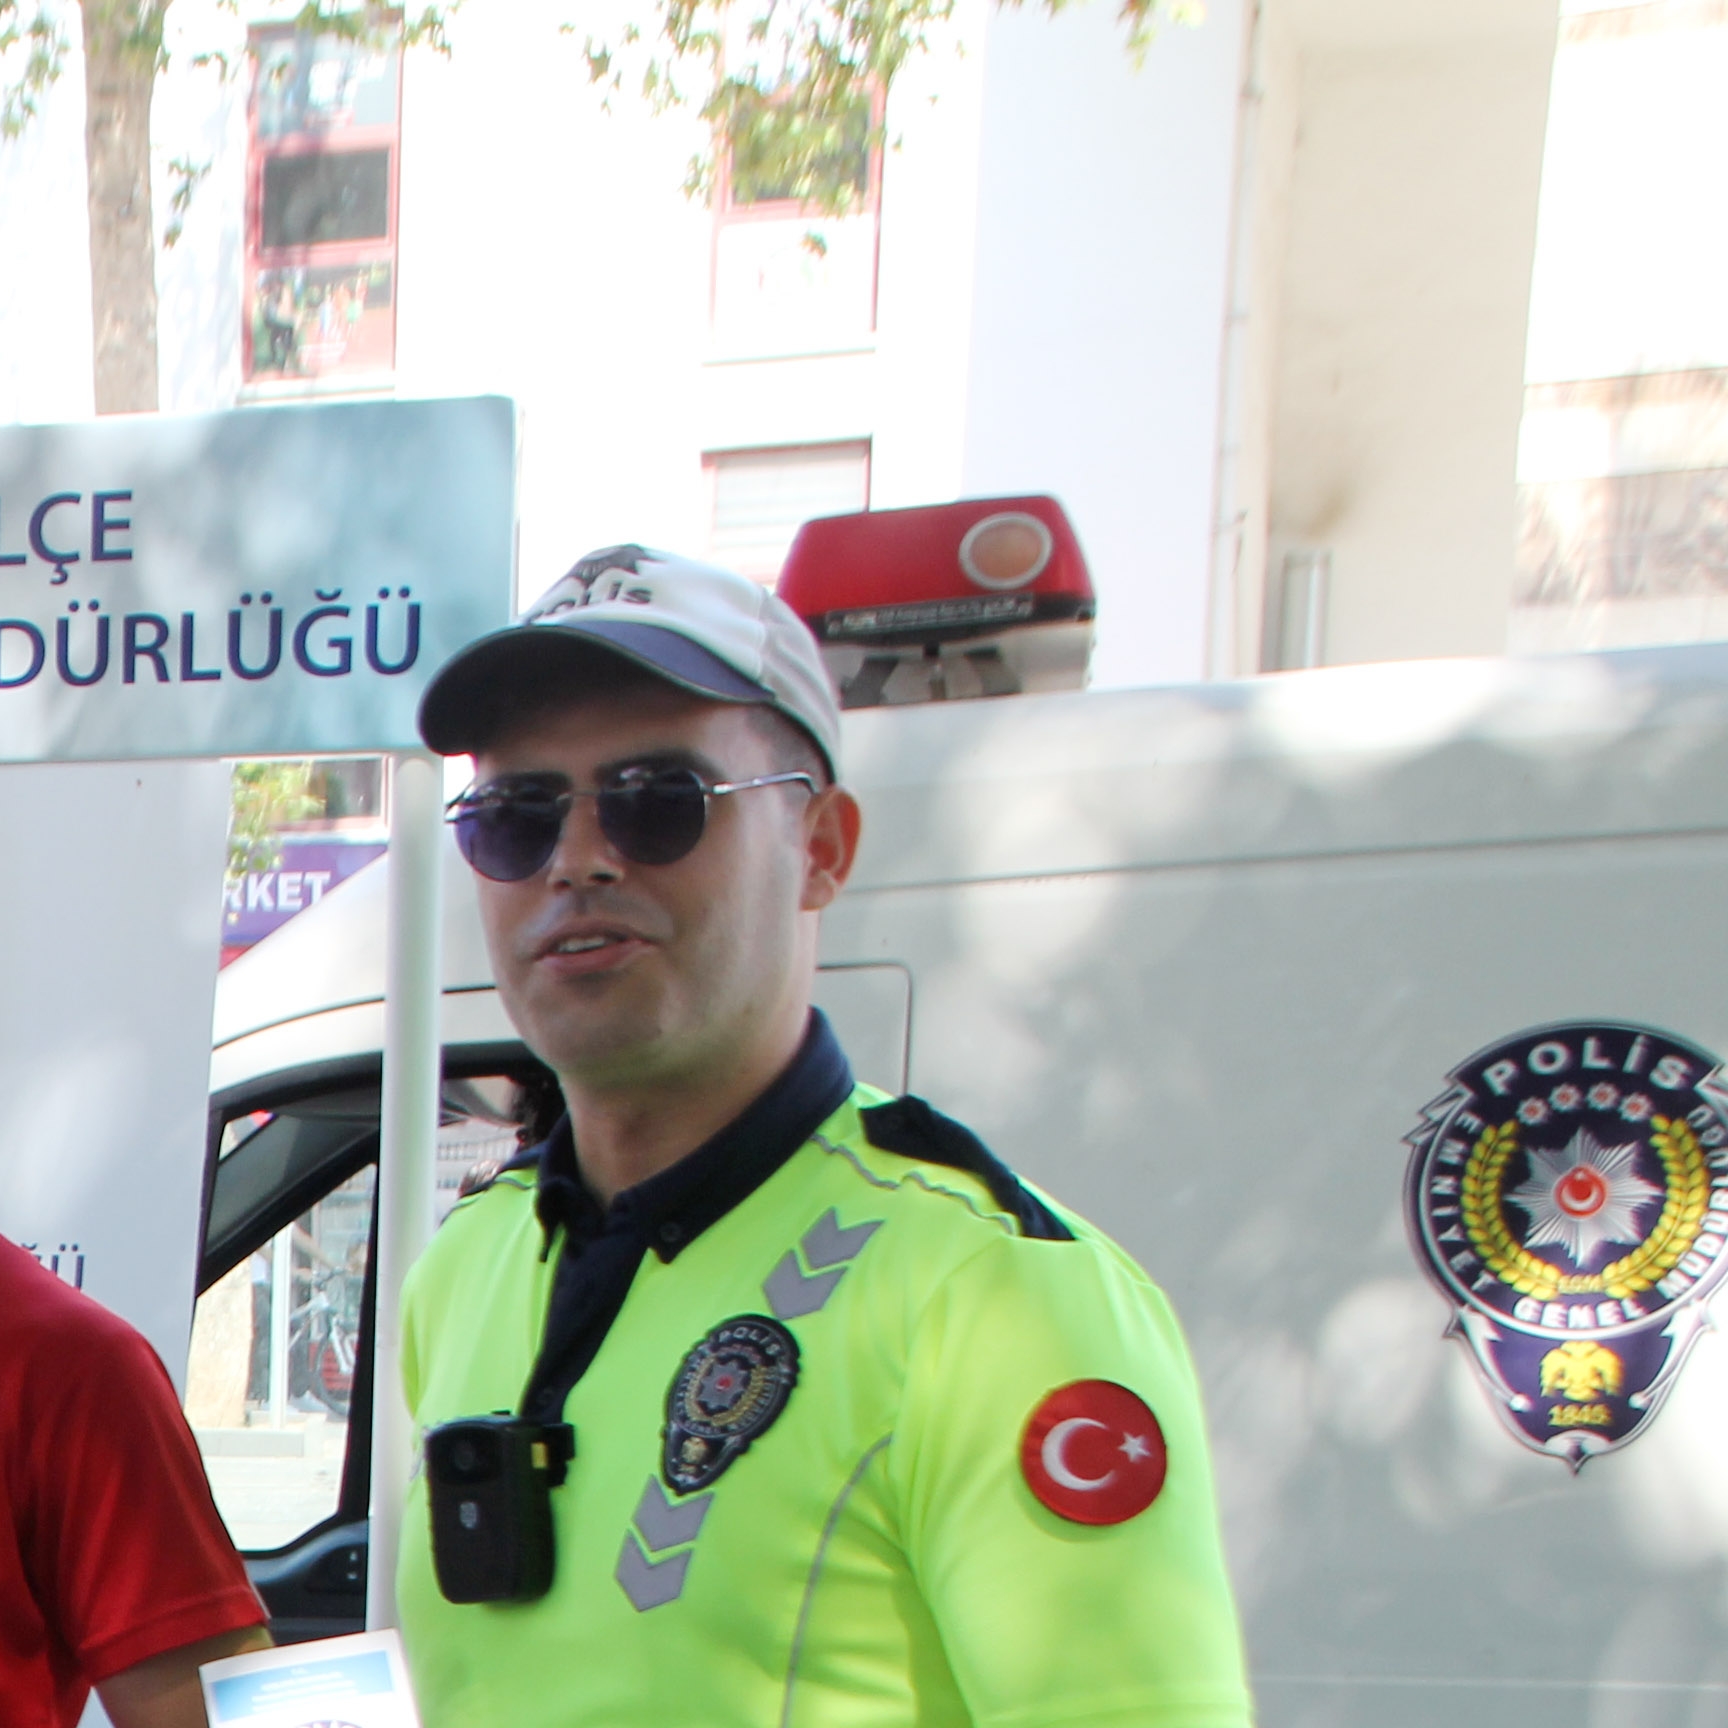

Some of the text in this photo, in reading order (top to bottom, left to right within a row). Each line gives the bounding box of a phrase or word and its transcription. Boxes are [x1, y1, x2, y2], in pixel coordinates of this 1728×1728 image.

[222, 870, 332, 912] RKET
[1482, 1034, 1693, 1096] POLİS
[1514, 1296, 1646, 1329] GENEL
